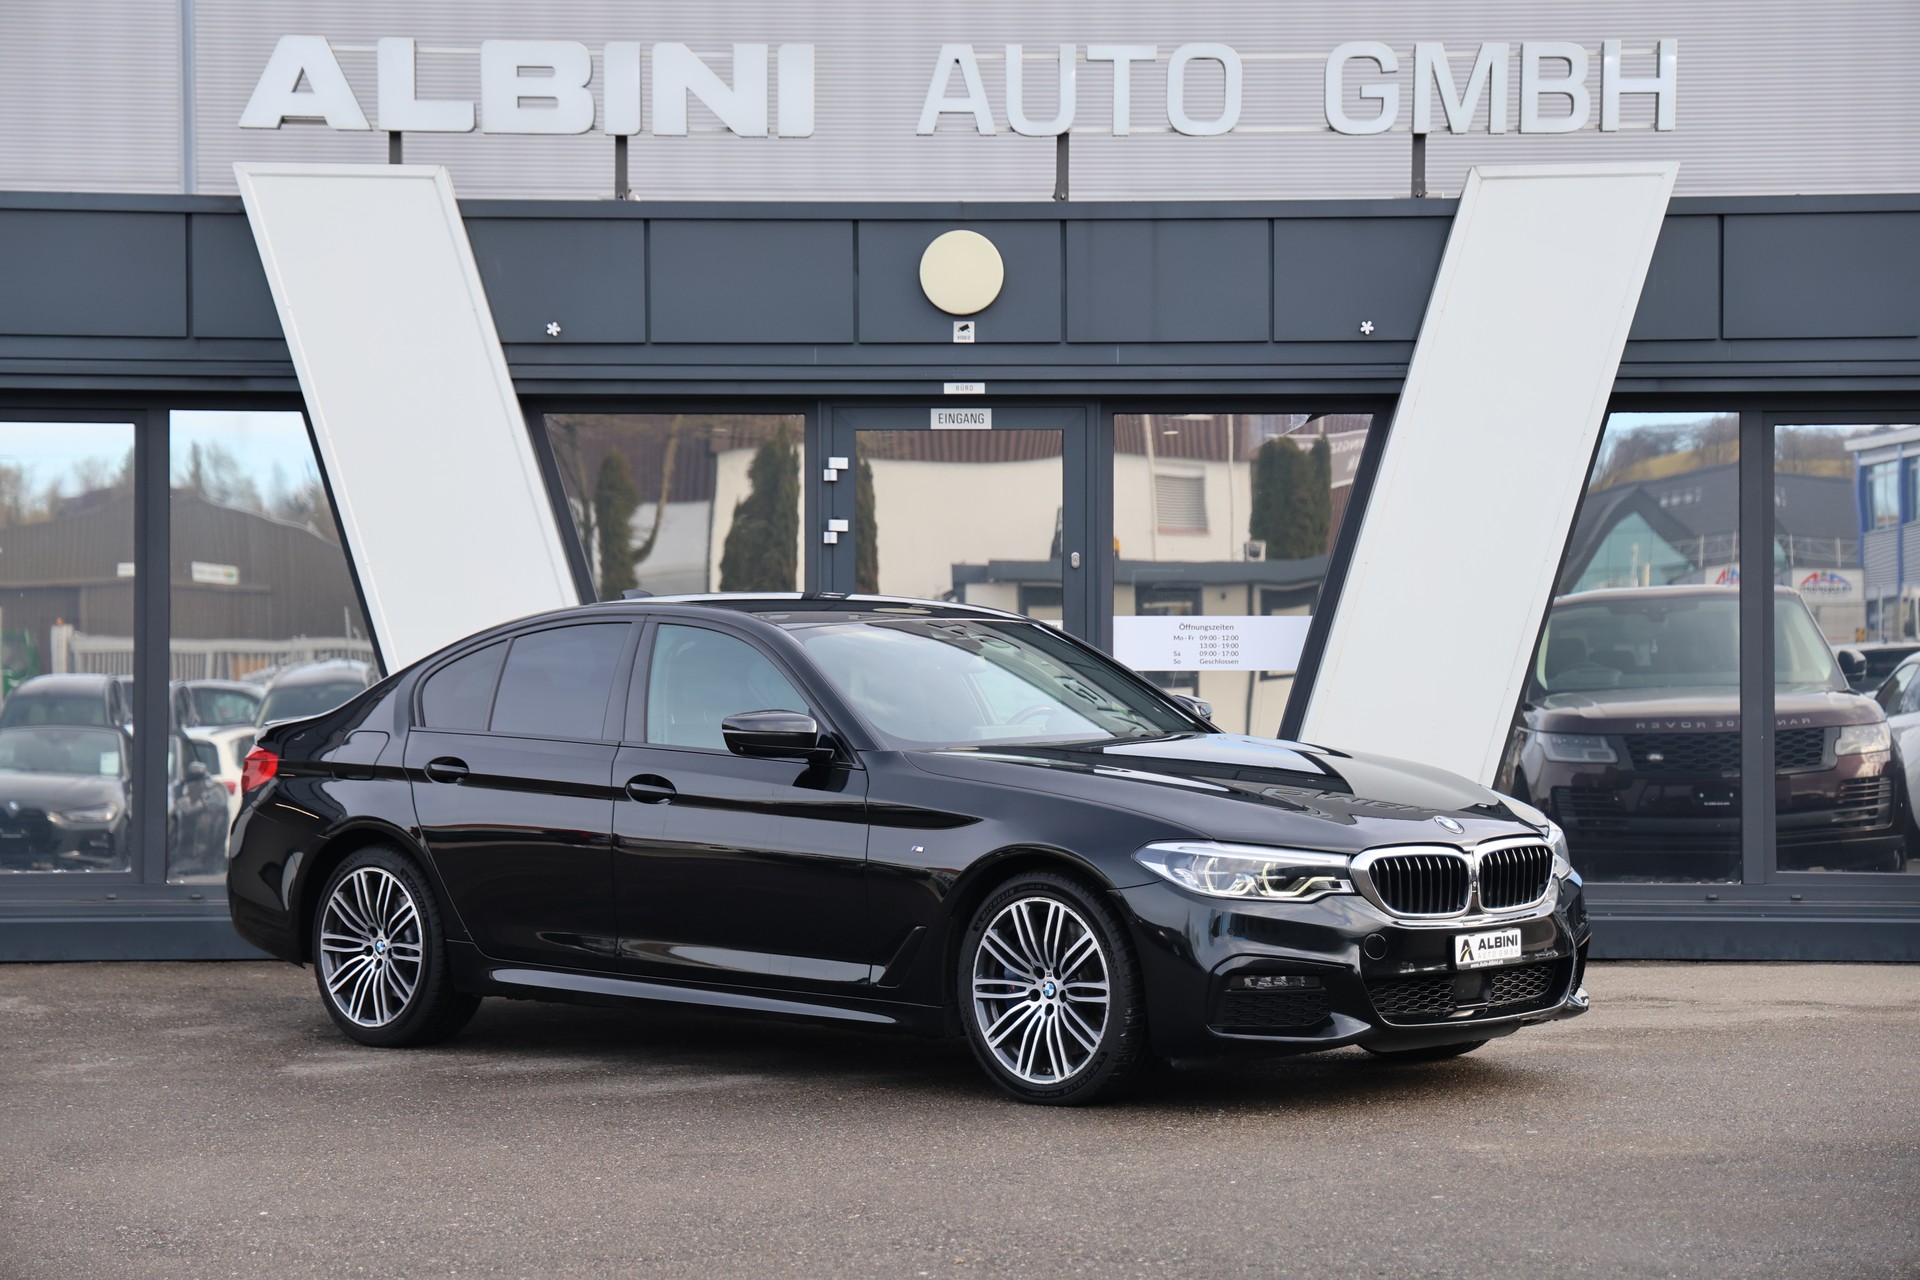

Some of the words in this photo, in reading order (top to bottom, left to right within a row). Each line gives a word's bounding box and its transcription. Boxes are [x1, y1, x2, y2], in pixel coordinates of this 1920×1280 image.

[238, 34, 815, 138] ALBINI
[916, 42, 1242, 137] AUTO
[1324, 39, 1679, 136] GMBH
[938, 413, 985, 424] EINGANG
[1178, 623, 1235, 632] Öffnungszeiten
[1478, 934, 1518, 950] ALBINI
[1478, 951, 1497, 959] AUTO
[1500, 948, 1519, 957] GMBH
